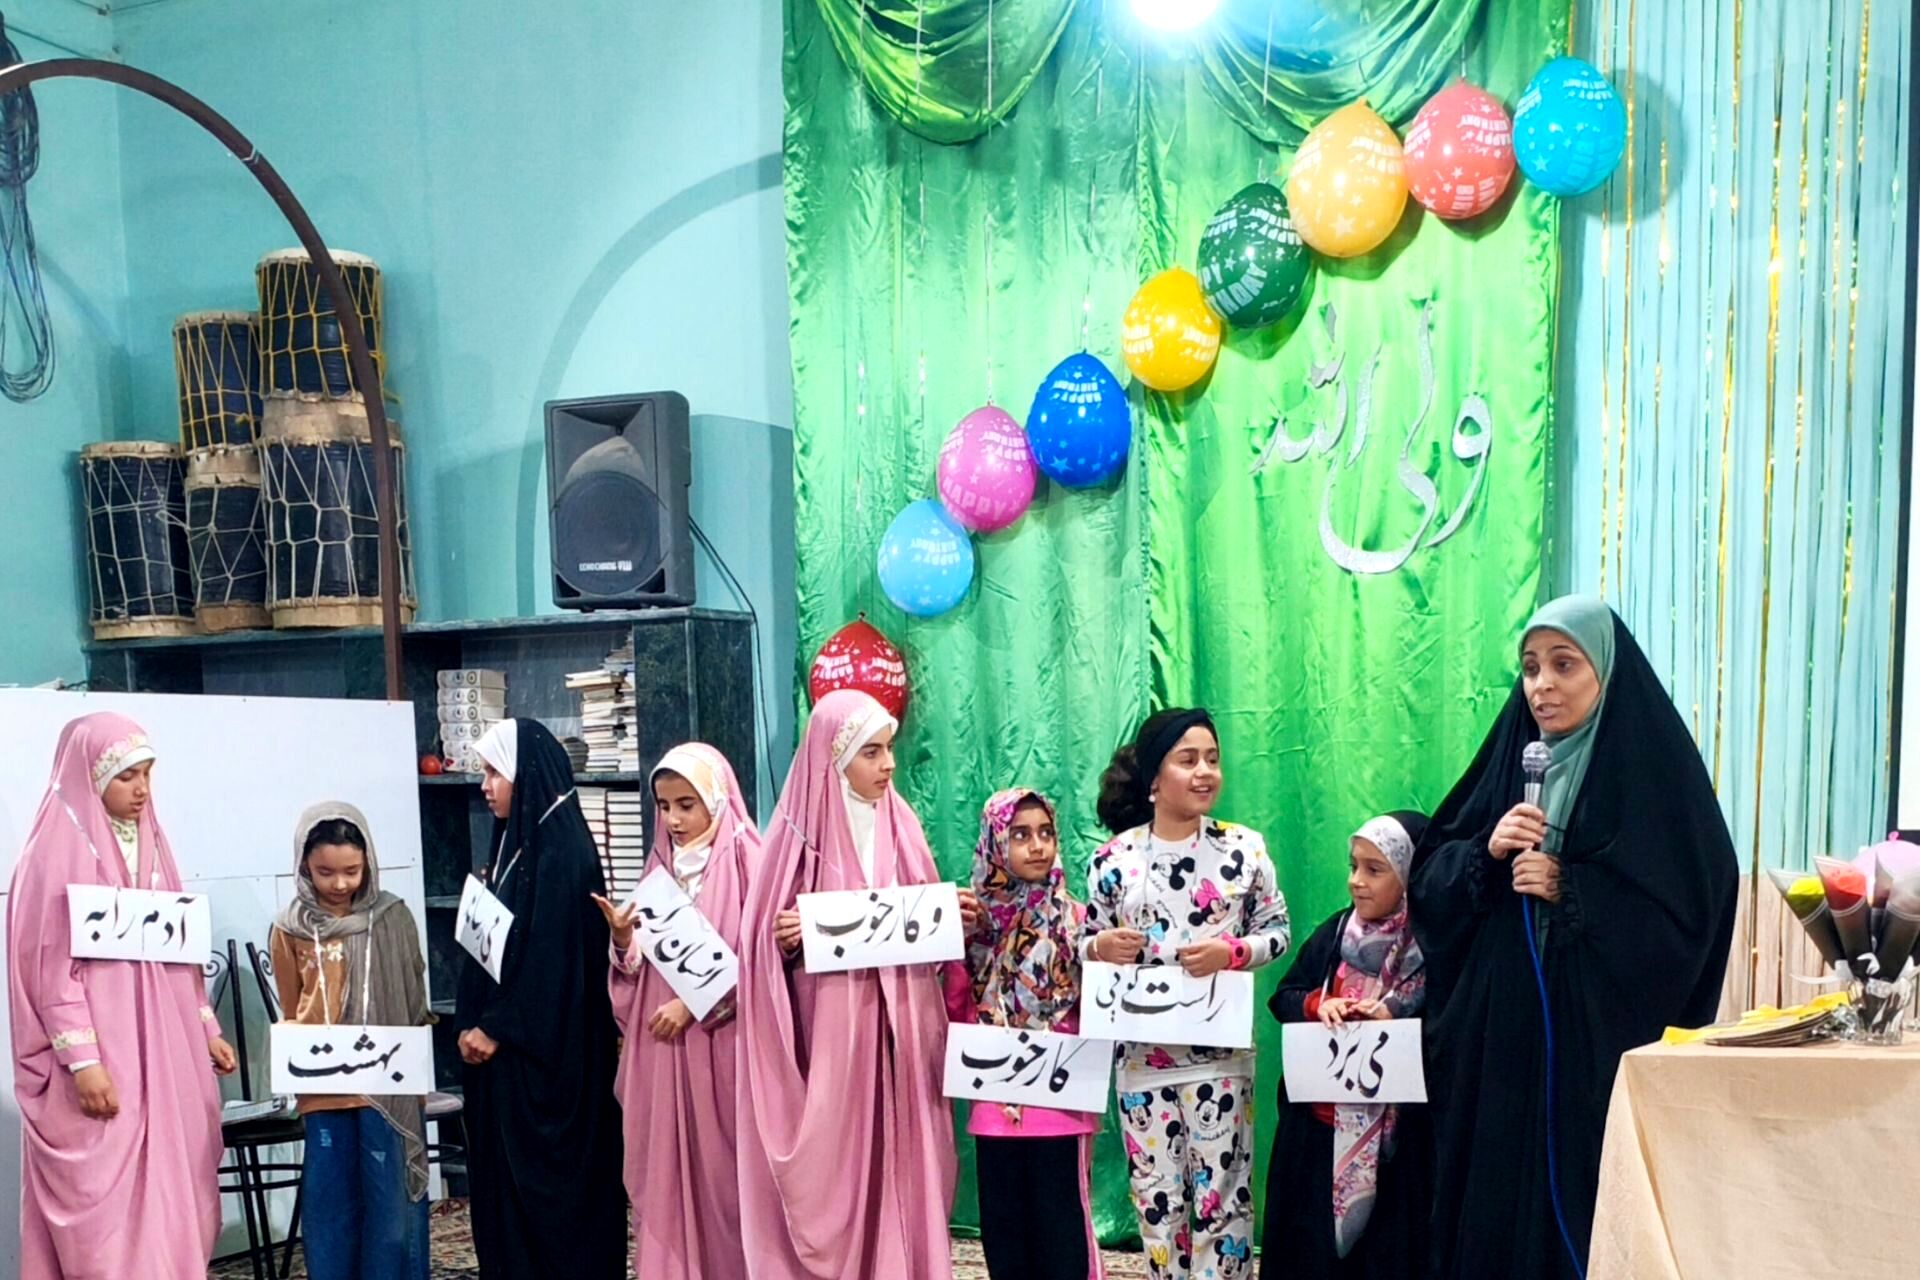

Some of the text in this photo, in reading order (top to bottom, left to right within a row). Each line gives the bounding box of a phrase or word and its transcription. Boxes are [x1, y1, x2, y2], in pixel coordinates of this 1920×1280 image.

[83, 890, 197, 956] آدم را به
[815, 886, 942, 959] و کار خوب
[653, 934, 729, 990] انسان
[287, 1033, 402, 1083] بهشت
[961, 1031, 1091, 1093] کار خوب
[1357, 1030, 1389, 1099] می
